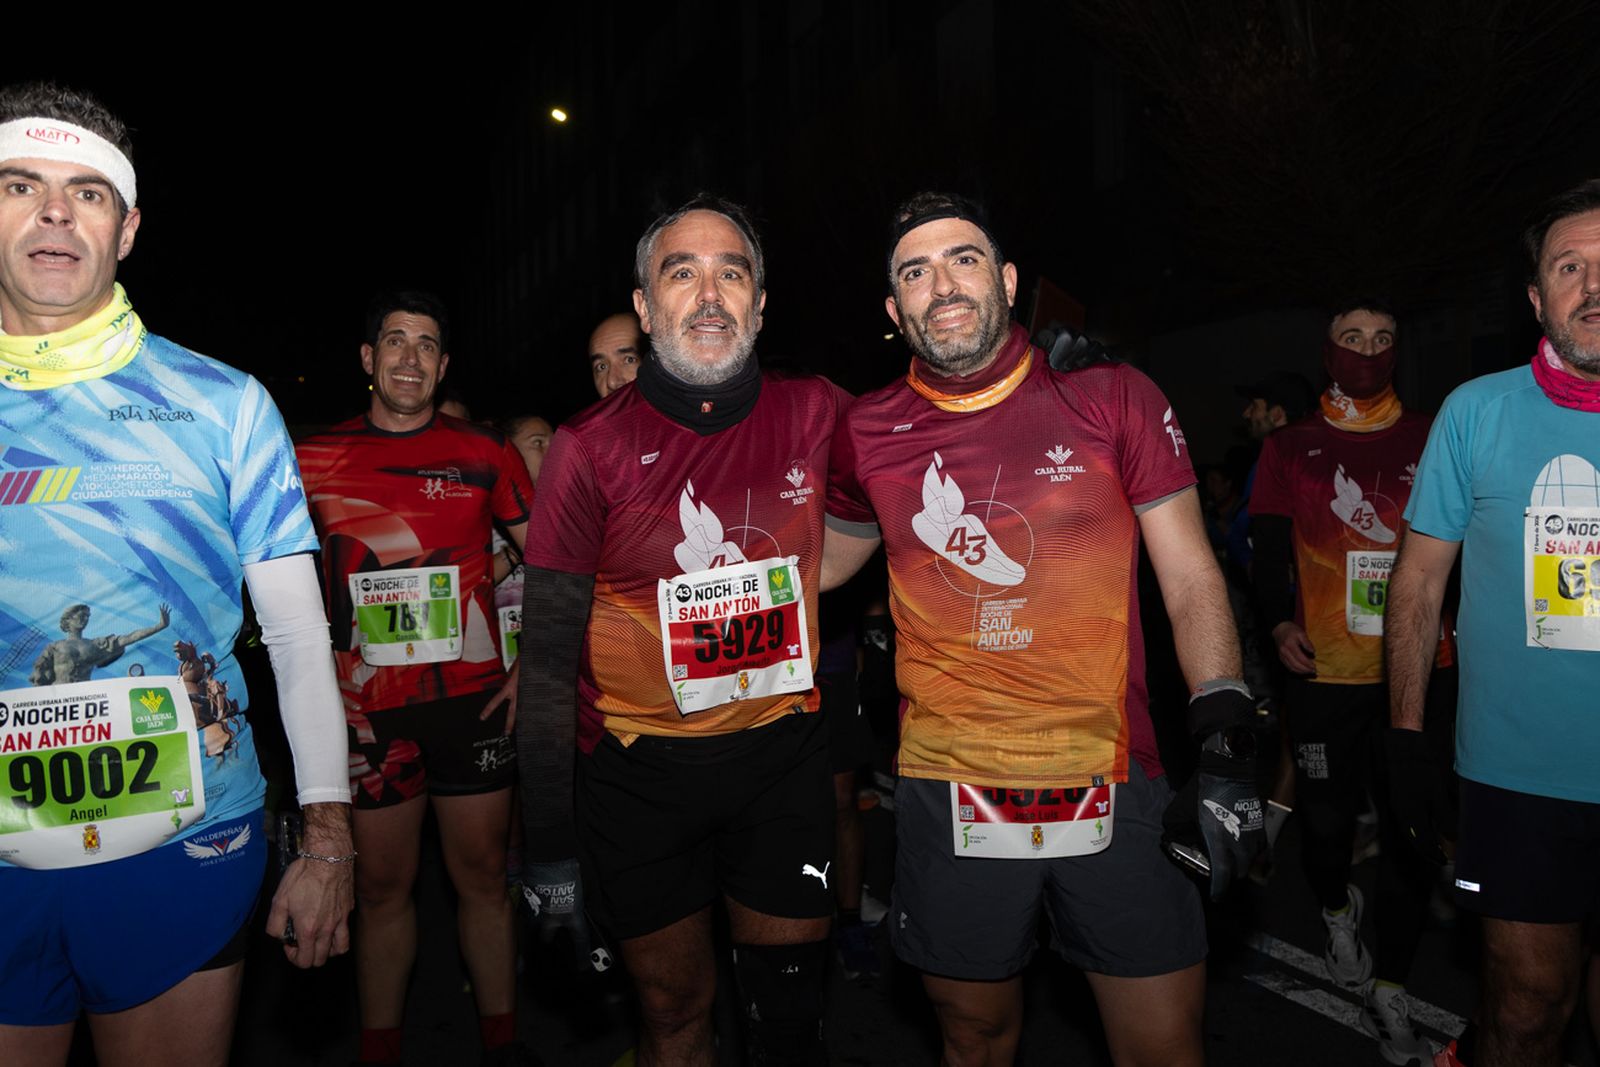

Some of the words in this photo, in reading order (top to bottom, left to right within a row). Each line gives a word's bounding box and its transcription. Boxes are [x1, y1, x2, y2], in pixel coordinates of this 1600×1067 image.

[34, 128, 70, 143] MATT
[109, 405, 142, 422] PATA
[1350, 507, 1375, 530] 43
[945, 526, 987, 566] 43
[1545, 539, 1580, 555] SAN
[1358, 570, 1378, 579] SAN
[677, 587, 691, 599] 43
[743, 579, 759, 593] DE
[363, 594, 383, 605] SAN
[679, 604, 709, 621] SAN
[713, 593, 760, 617] ANTÓN
[979, 616, 1012, 632] SAN
[693, 610, 784, 663] 5929
[977, 625, 1033, 647] ANTÓN
[12, 701, 38, 709] CARRERA
[38, 698, 62, 706] URBANA
[13, 704, 79, 727] NOCHE
[85, 700, 109, 719] DE
[0, 731, 32, 753] AN
[38, 719, 112, 749] ANTÓN
[8, 740, 161, 810] 9002
[70, 804, 108, 821] Angel
[193, 825, 244, 844] VALDEPEÑAS
